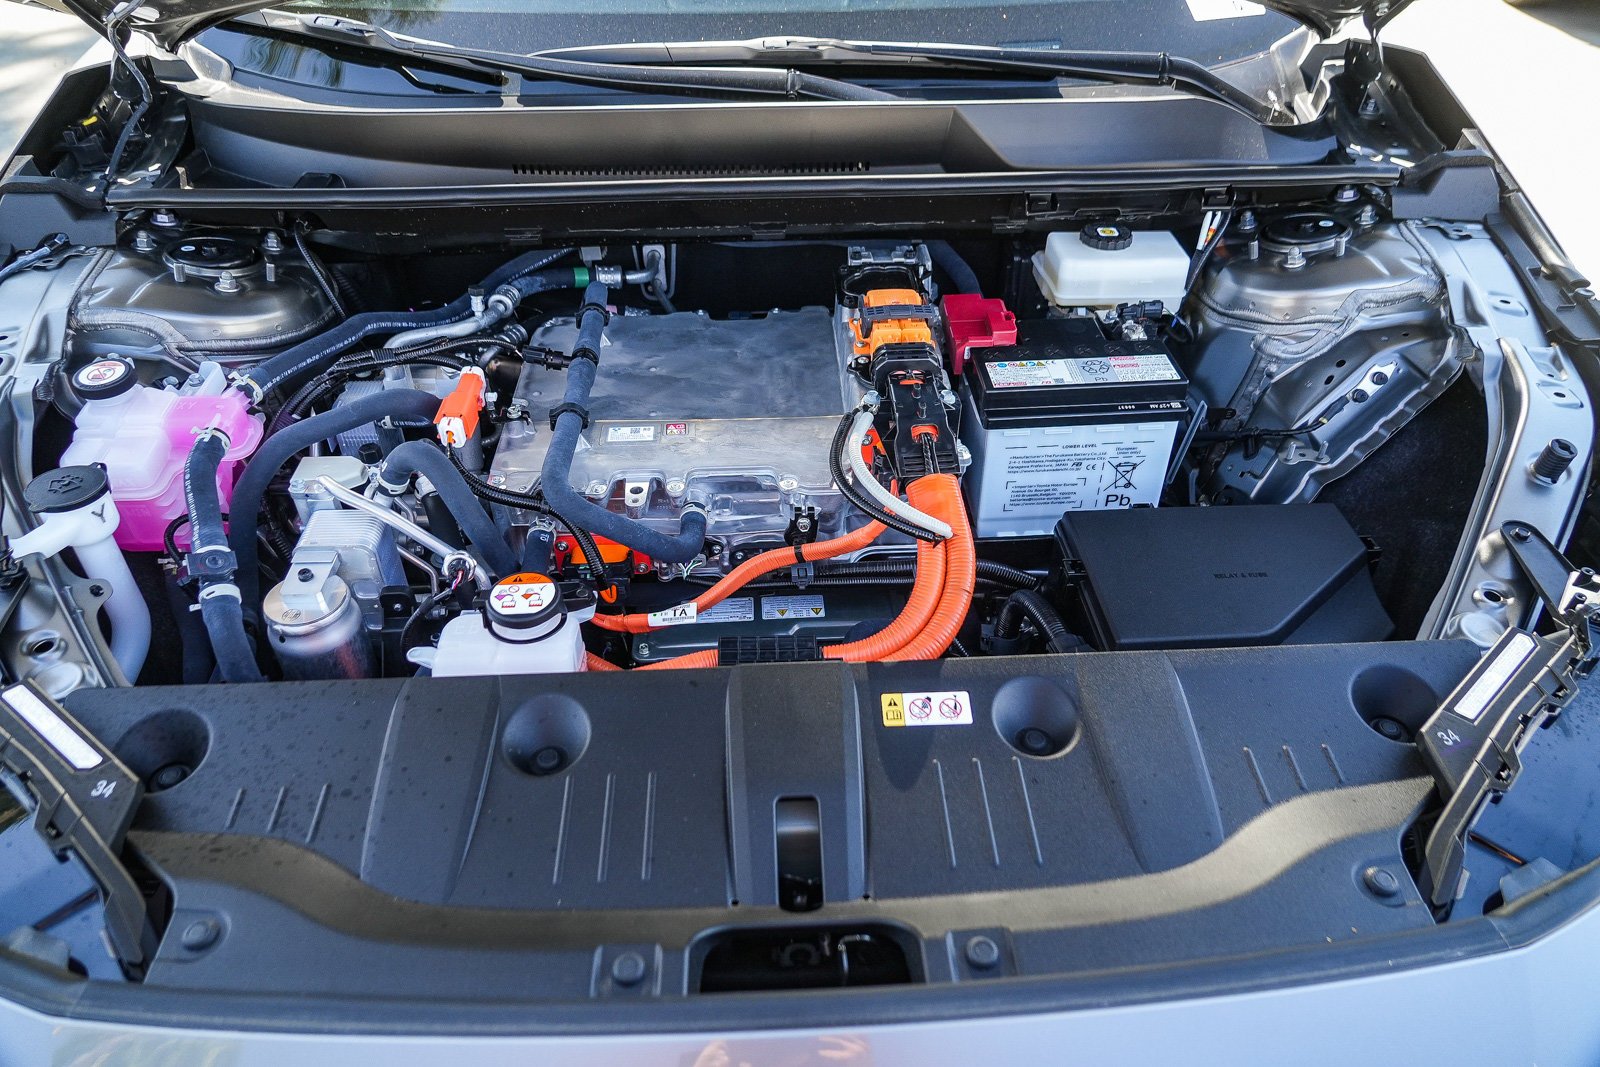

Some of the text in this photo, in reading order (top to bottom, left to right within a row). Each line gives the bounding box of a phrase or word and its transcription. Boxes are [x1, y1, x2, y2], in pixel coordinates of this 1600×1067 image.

[1104, 494, 1130, 507] Pb
[1436, 729, 1460, 746] 34
[90, 780, 117, 798] 34
